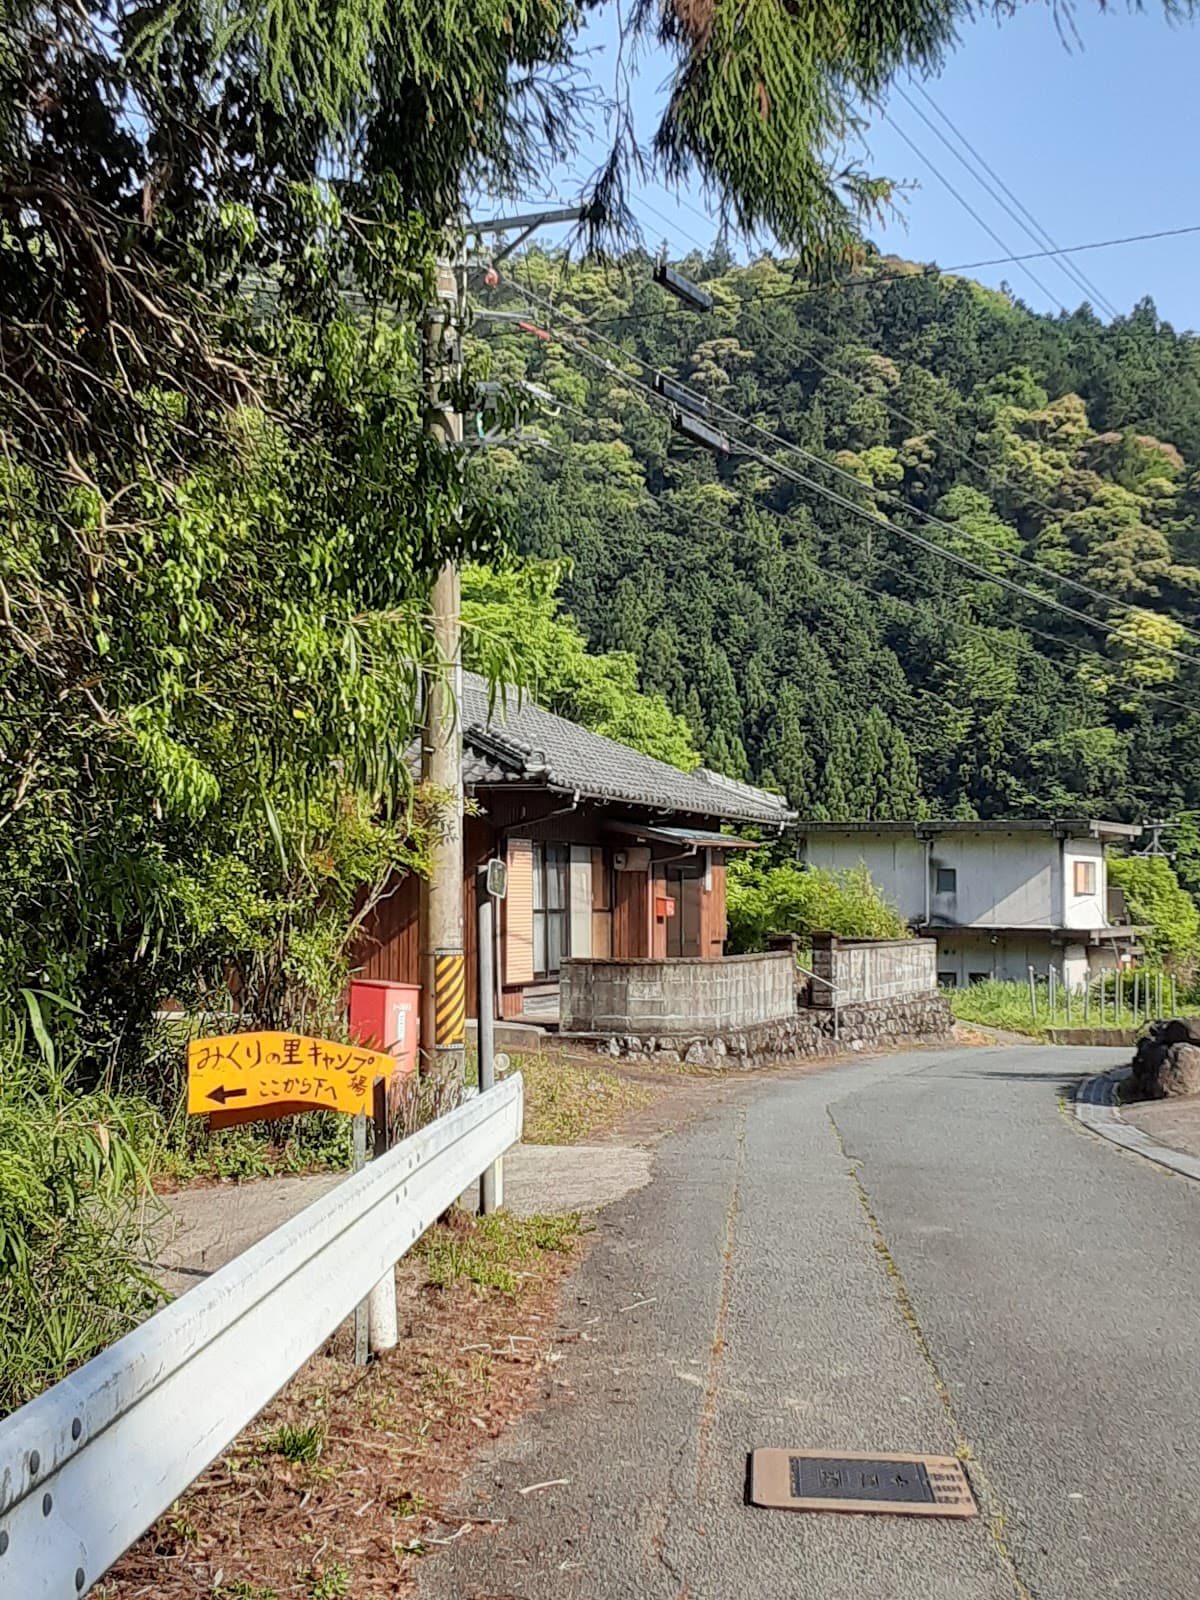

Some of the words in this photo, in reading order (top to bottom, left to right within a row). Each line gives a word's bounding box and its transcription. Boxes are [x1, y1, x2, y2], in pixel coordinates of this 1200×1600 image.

[259, 1077, 338, 1100] ここから下へ
